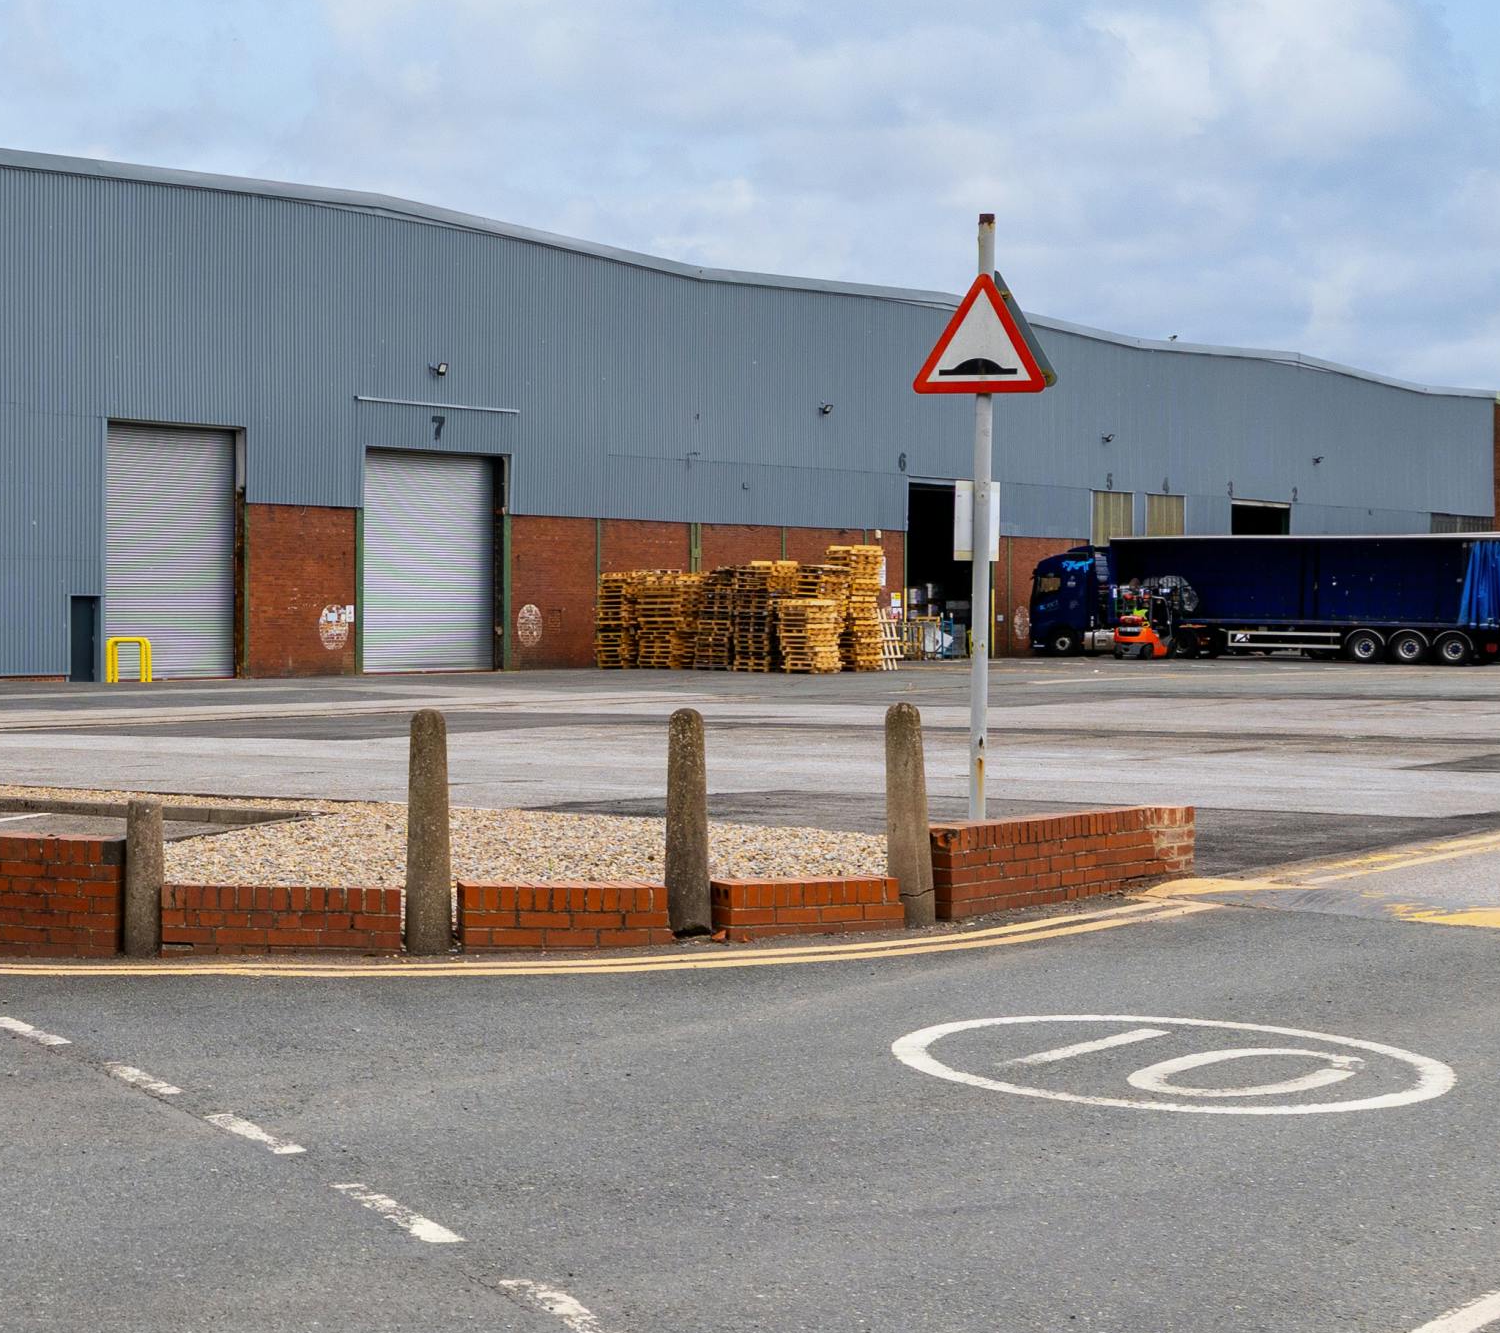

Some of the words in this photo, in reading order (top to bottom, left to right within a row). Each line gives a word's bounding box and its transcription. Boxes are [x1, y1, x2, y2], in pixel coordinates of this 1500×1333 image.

[431, 415, 446, 442] 7
[898, 452, 907, 472] 6
[1106, 472, 1113, 490] 5
[1162, 477, 1170, 494] 4
[1292, 486, 1298, 502] 2
[1002, 1027, 1366, 1098] 10
